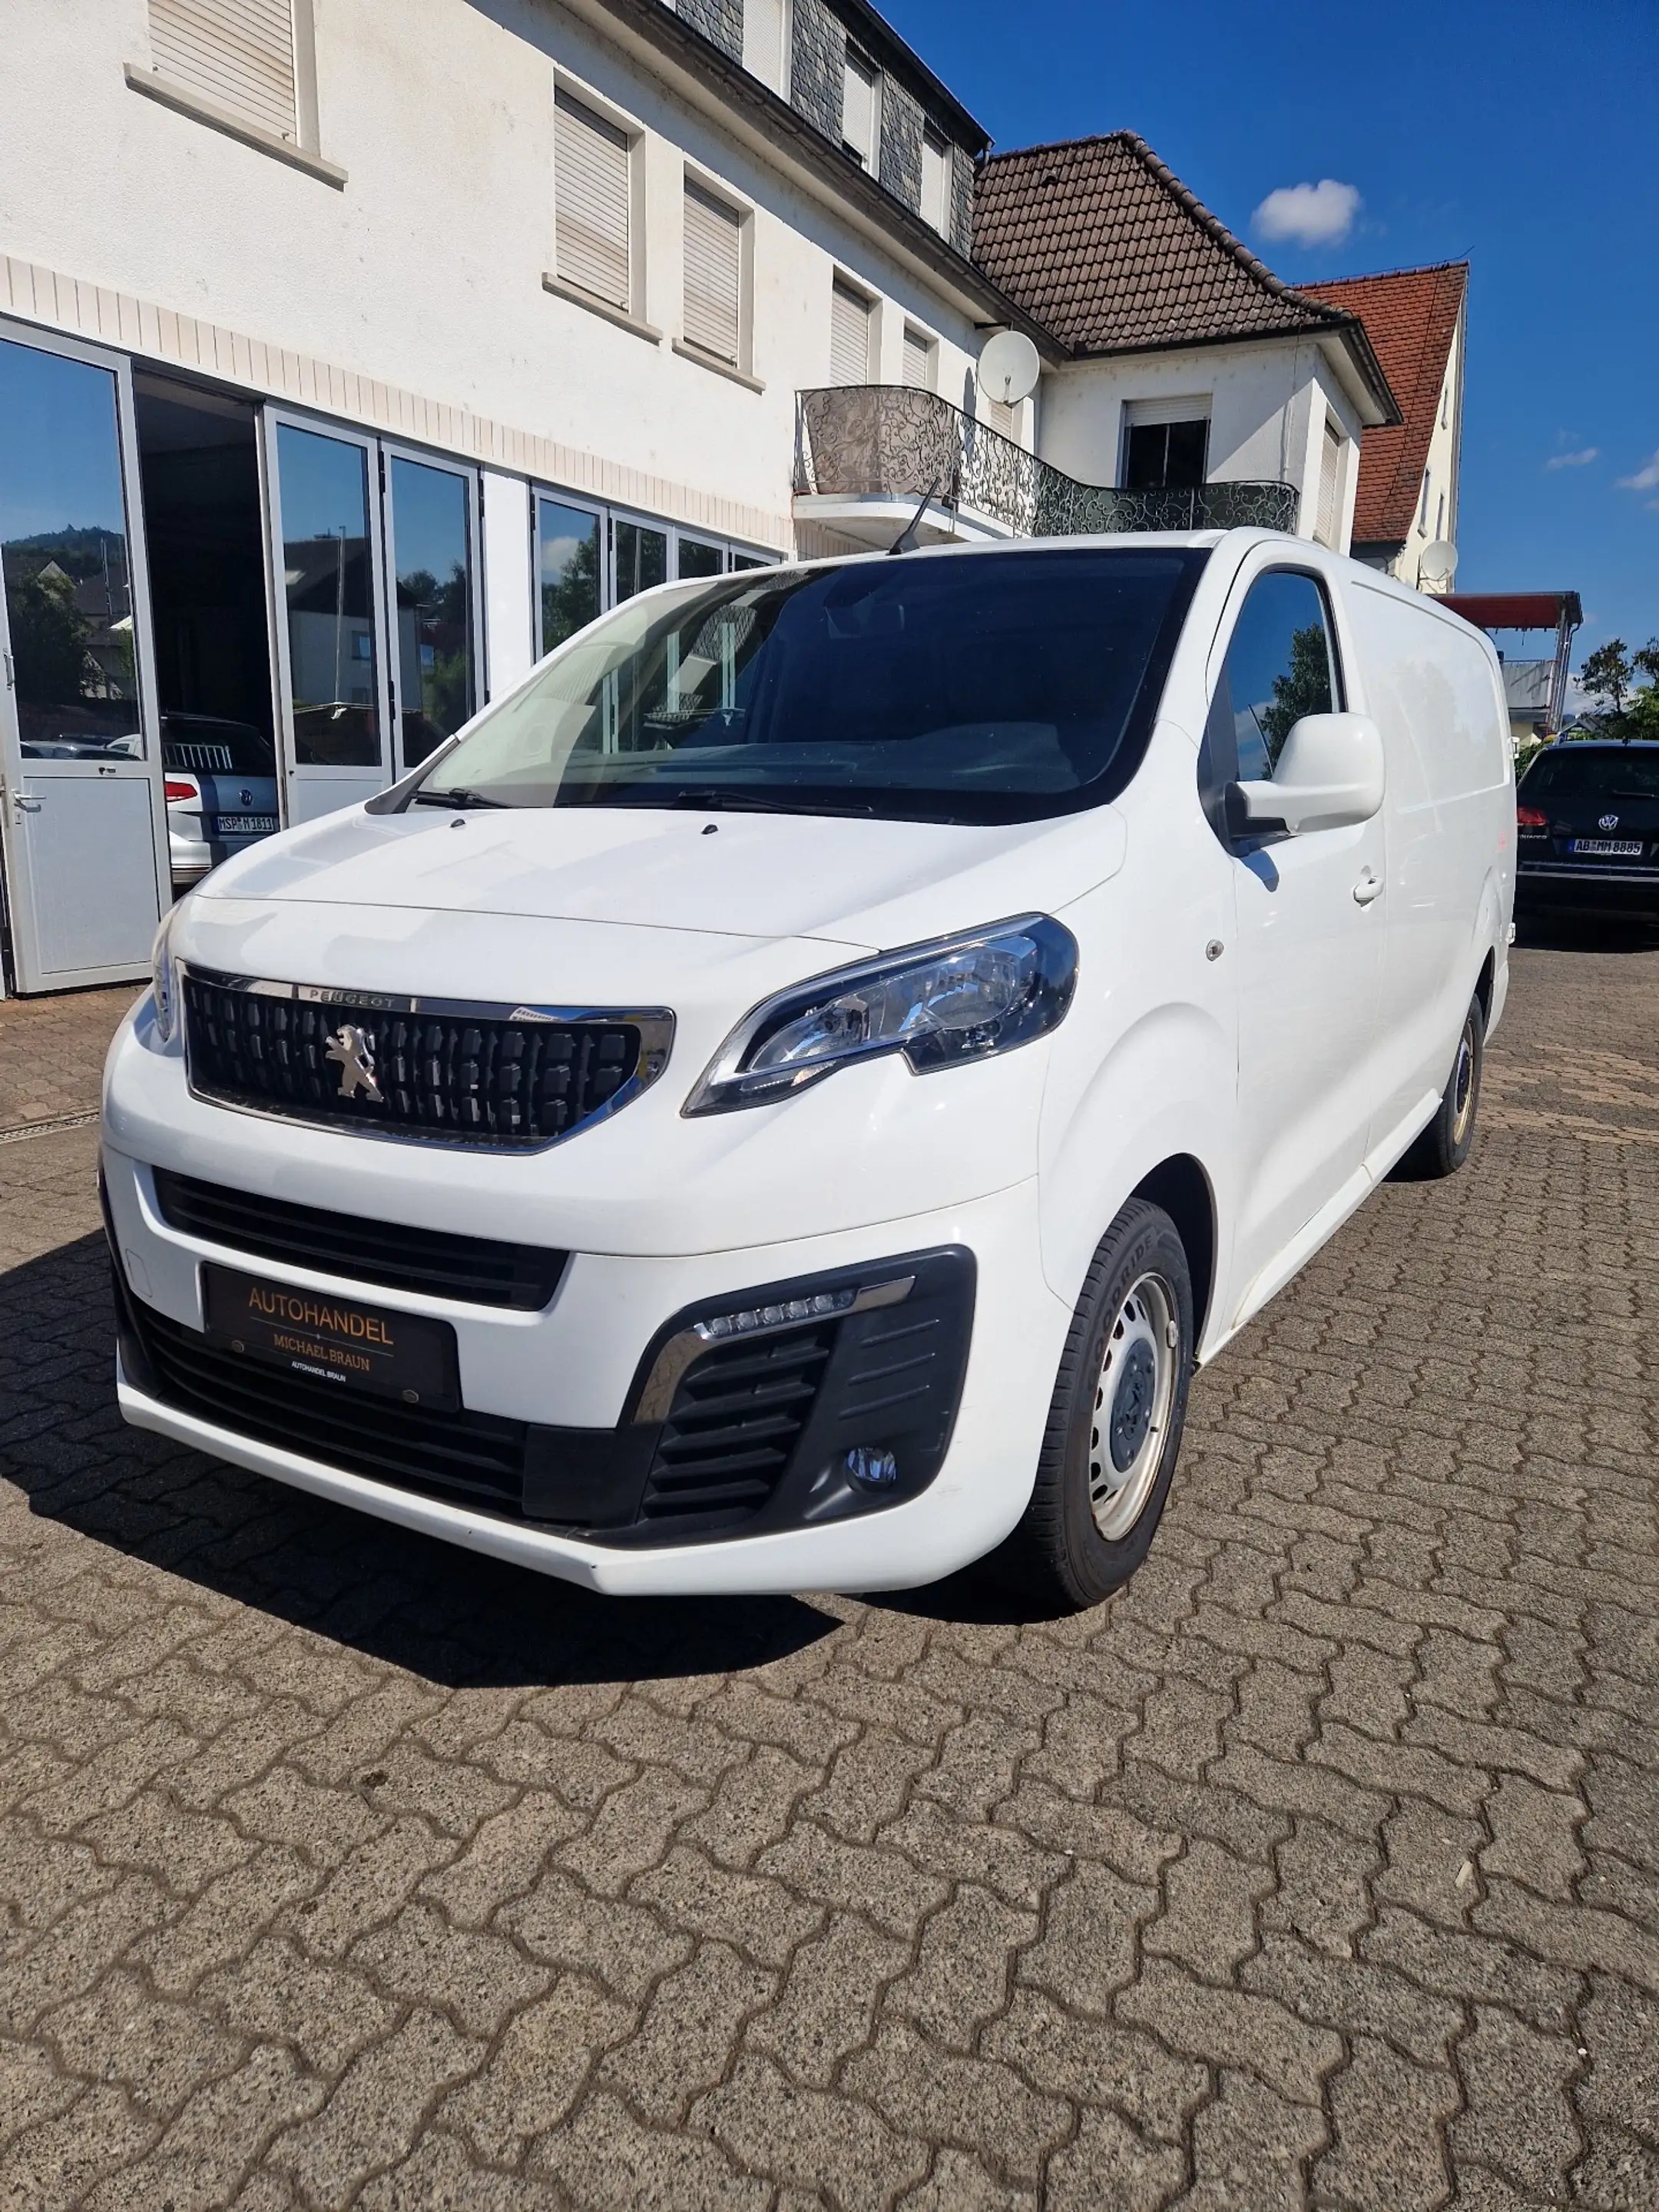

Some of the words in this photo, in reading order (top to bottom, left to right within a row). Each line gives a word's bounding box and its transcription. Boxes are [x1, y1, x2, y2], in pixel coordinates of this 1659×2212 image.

[219, 817, 237, 830] MSP
[251, 817, 273, 830] 1811
[1576, 840, 1590, 851] AB
[310, 988, 395, 1008] PEUGEOT
[249, 1287, 394, 1345] AUTOHANDEL
[273, 1333, 329, 1360] MICHAEL
[329, 1349, 370, 1372] BRAUN
[291, 1360, 326, 1377] AUTOHANDEL
[326, 1371, 346, 1382] BRAUN
